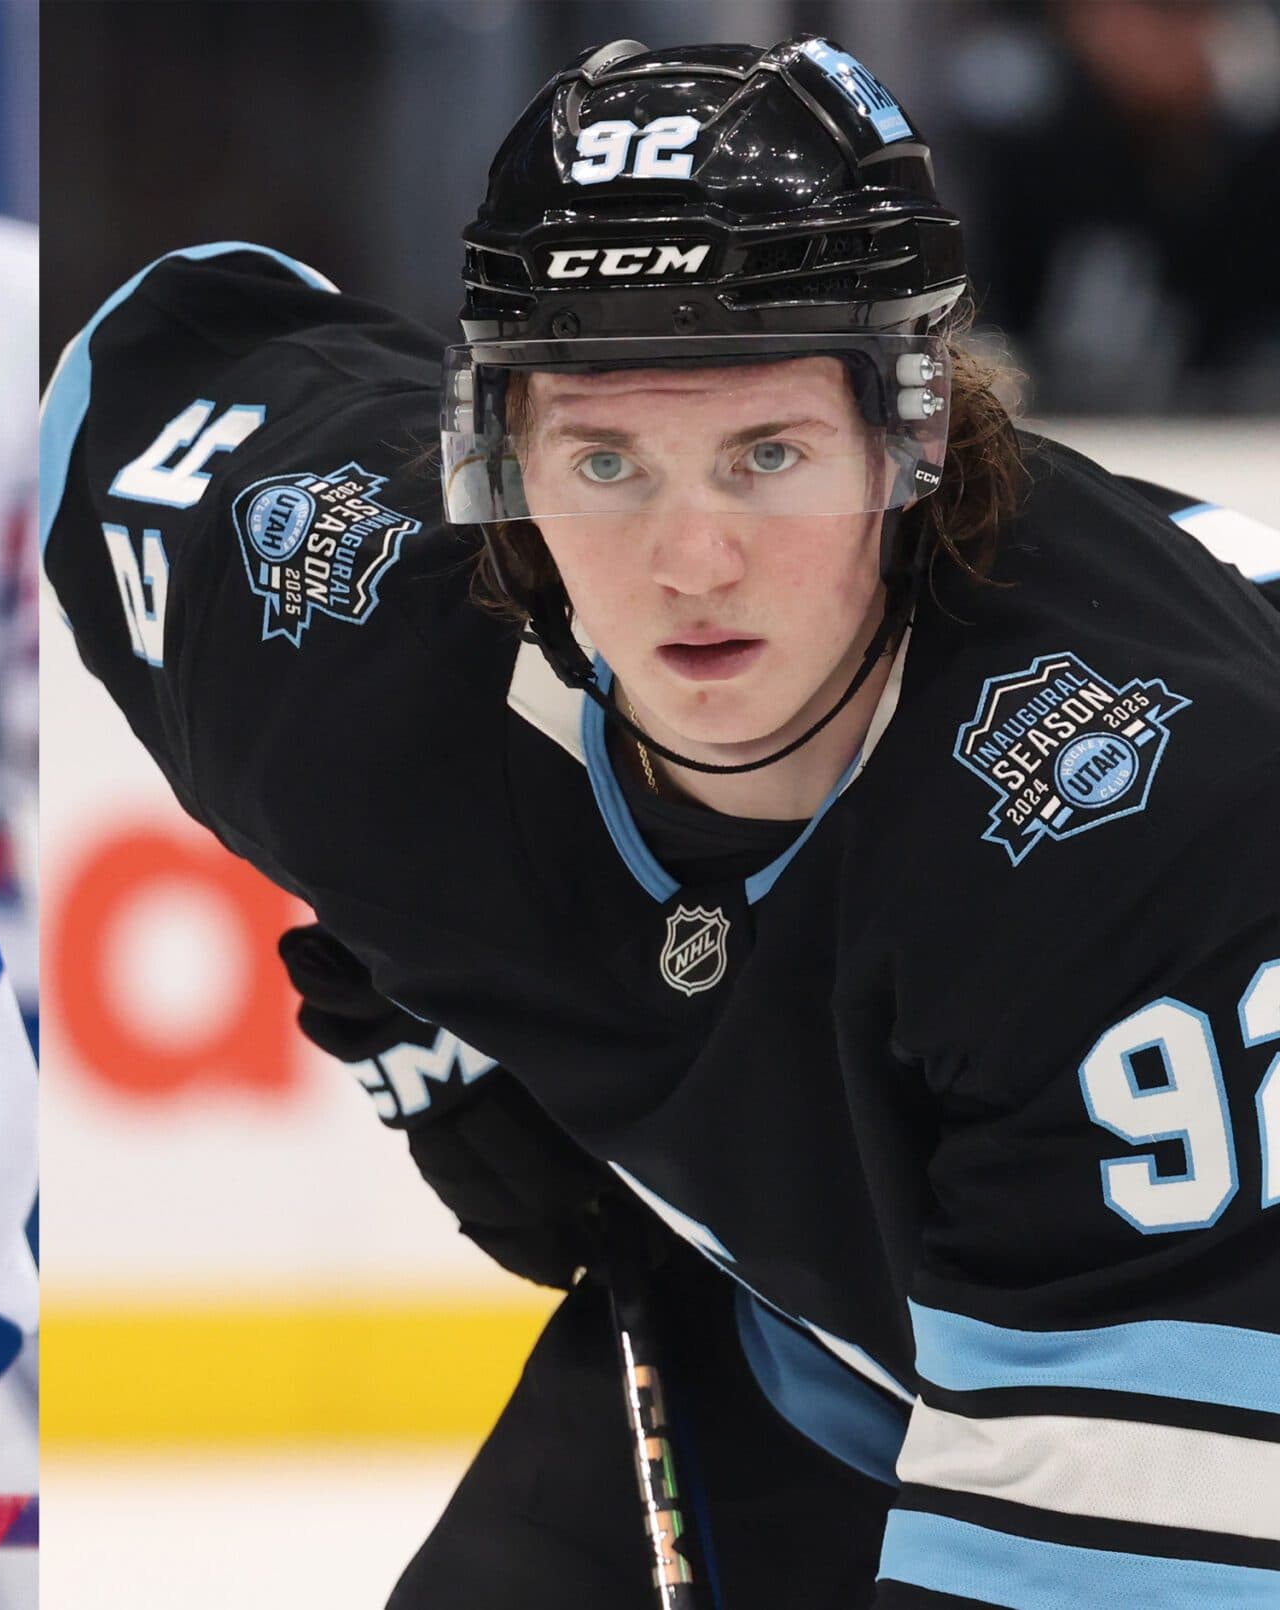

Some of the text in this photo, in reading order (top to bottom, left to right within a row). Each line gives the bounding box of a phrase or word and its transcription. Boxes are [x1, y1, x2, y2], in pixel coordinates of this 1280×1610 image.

[570, 115, 703, 185] 92
[546, 243, 711, 279] CCM
[320, 481, 363, 503] 2024
[915, 469, 940, 485] CCM
[250, 496, 270, 533] CLUB
[261, 492, 301, 551] UTAH
[304, 498, 380, 604] SEASON
[285, 567, 302, 616] 2025
[972, 671, 1089, 769] INAUGURAL
[1103, 692, 1150, 729] 2025
[992, 682, 1115, 791] SEASON
[1062, 738, 1108, 776] HOCKEY
[1068, 743, 1128, 796] UTAH
[1099, 769, 1130, 799] CLUB
[1006, 778, 1050, 826] 2024
[675, 930, 715, 973] NHL
